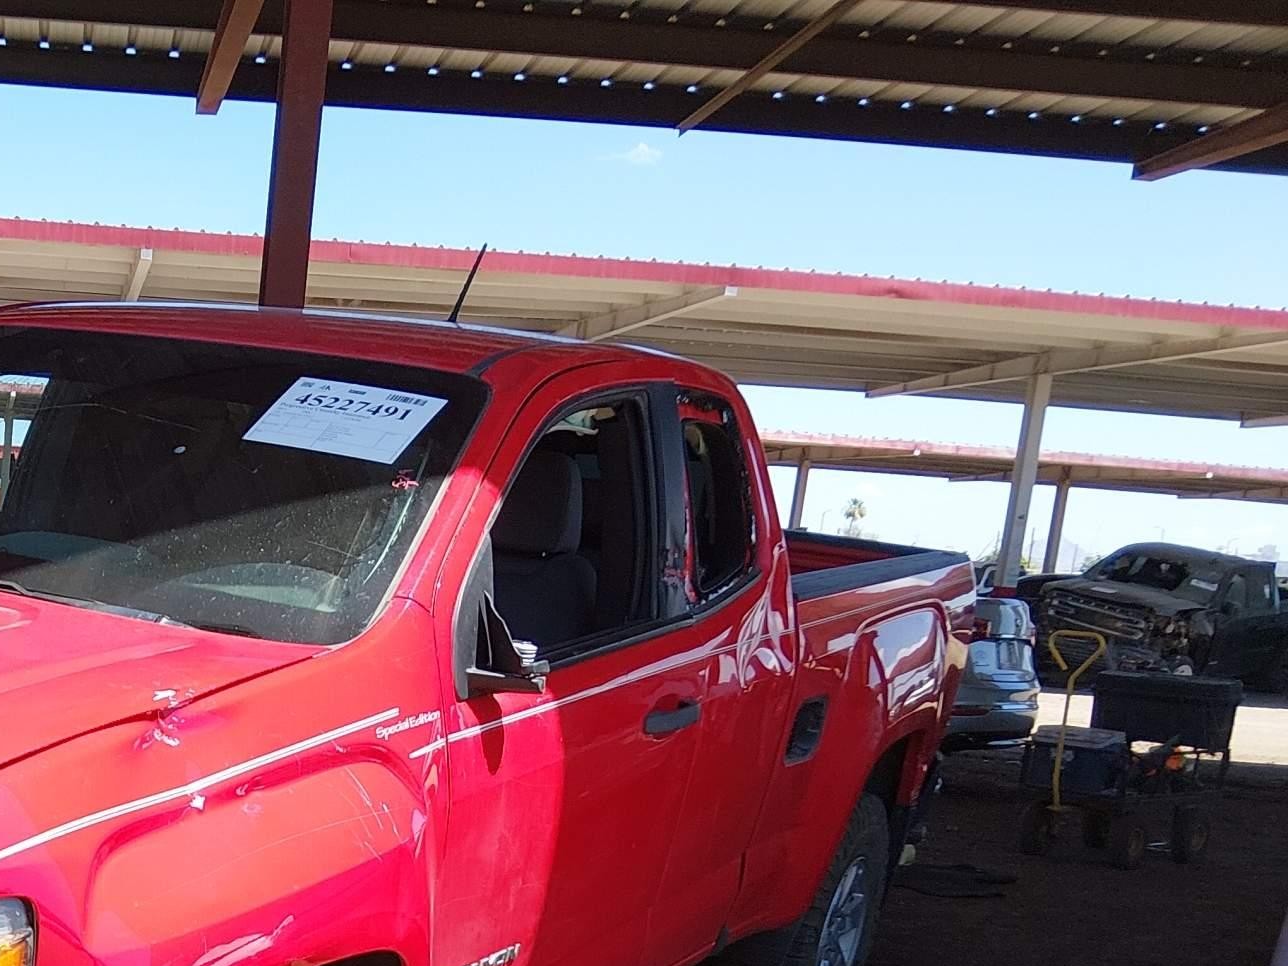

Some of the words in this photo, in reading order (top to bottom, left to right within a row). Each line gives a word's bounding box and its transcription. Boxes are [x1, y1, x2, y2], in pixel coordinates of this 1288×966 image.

[295, 392, 412, 421] 45227491
[375, 716, 410, 740] Special
[409, 710, 441, 729] Edition
